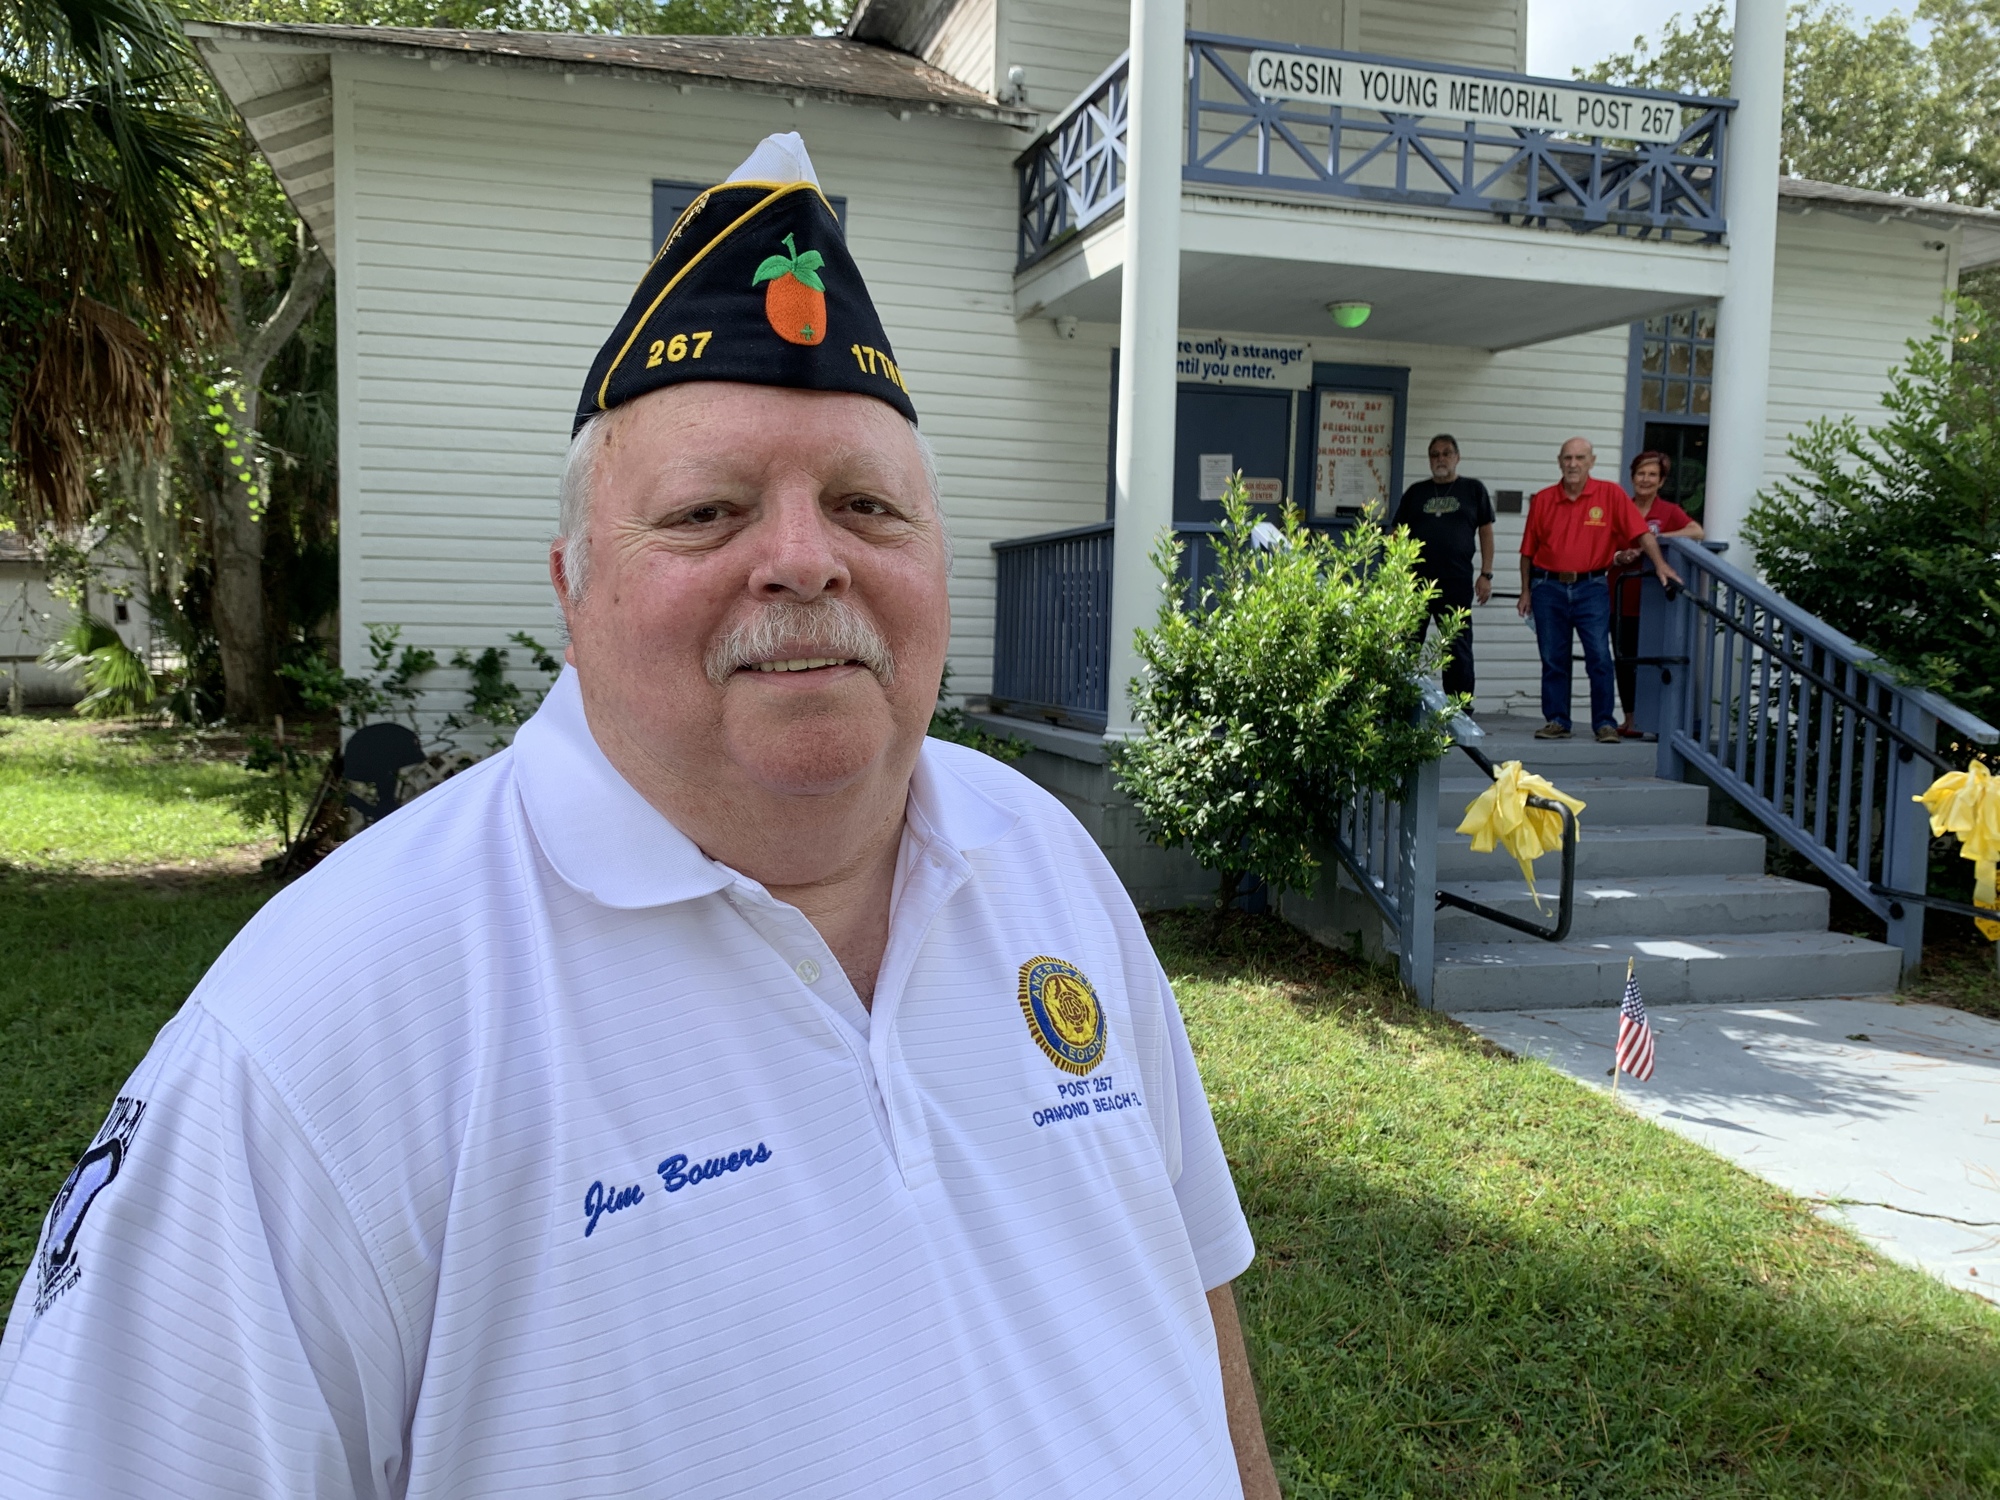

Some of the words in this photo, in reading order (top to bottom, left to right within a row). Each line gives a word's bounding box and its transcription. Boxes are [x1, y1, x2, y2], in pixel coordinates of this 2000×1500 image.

[1258, 57, 1342, 97] CASSIN
[1360, 69, 1438, 108] YOUNG
[1449, 81, 1563, 123] MEMORIAL
[1577, 96, 1633, 131] POST
[1641, 106, 1675, 135] 267
[645, 331, 713, 370] 267
[1195, 339, 1227, 360] only
[1231, 345, 1239, 356] a
[1243, 344, 1303, 365] stranger
[1177, 357, 1199, 375] ntil
[1201, 361, 1229, 380] you
[1233, 363, 1275, 379] enter.
[1330, 399, 1355, 410] POST
[1347, 410, 1365, 421] THE
[1322, 422, 1385, 434] FRIENDLIEST
[1331, 434, 1357, 444] POST
[1363, 435, 1374, 444] IN
[1060, 1037, 1102, 1061] LEGION
[1057, 1080, 1091, 1099] POST
[1093, 1076, 1113, 1093] 267
[1033, 1101, 1090, 1128] ORMOND
[1092, 1093, 1132, 1113] BEACH
[584, 1180, 645, 1238] Jim
[657, 1142, 773, 1193] Bowers
